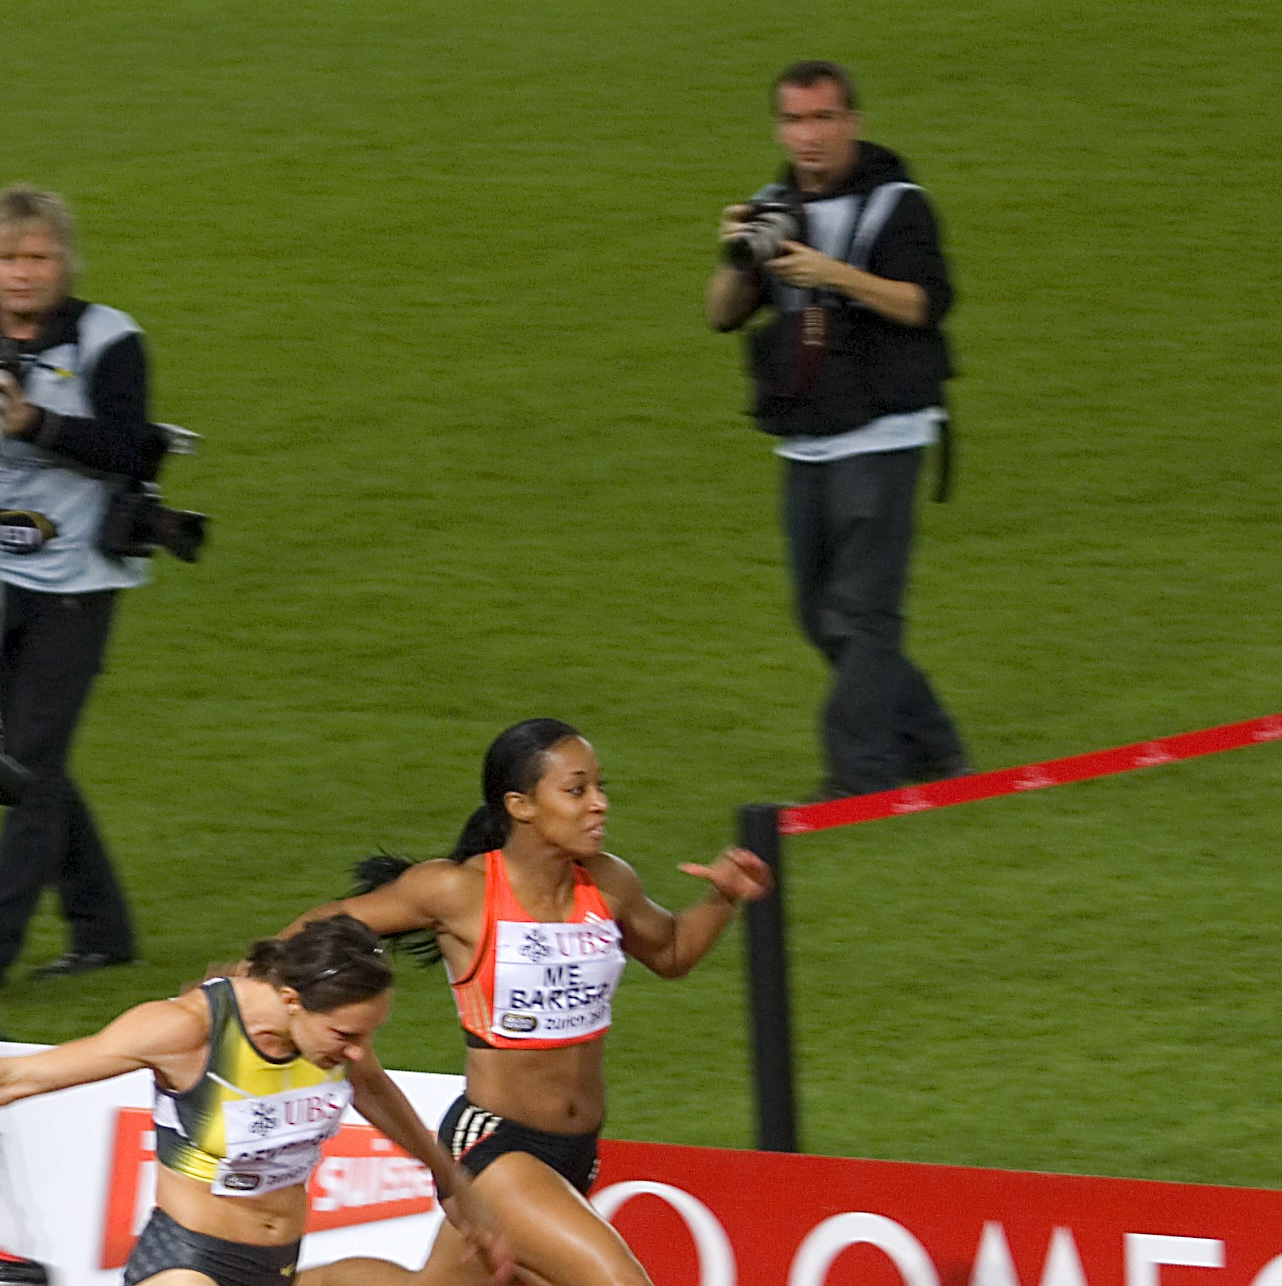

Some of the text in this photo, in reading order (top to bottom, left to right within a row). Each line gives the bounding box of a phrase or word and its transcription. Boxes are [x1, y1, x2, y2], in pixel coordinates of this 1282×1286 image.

[554, 932, 613, 957] UBS
[544, 965, 582, 986] ME
[511, 983, 609, 1008] BARBER
